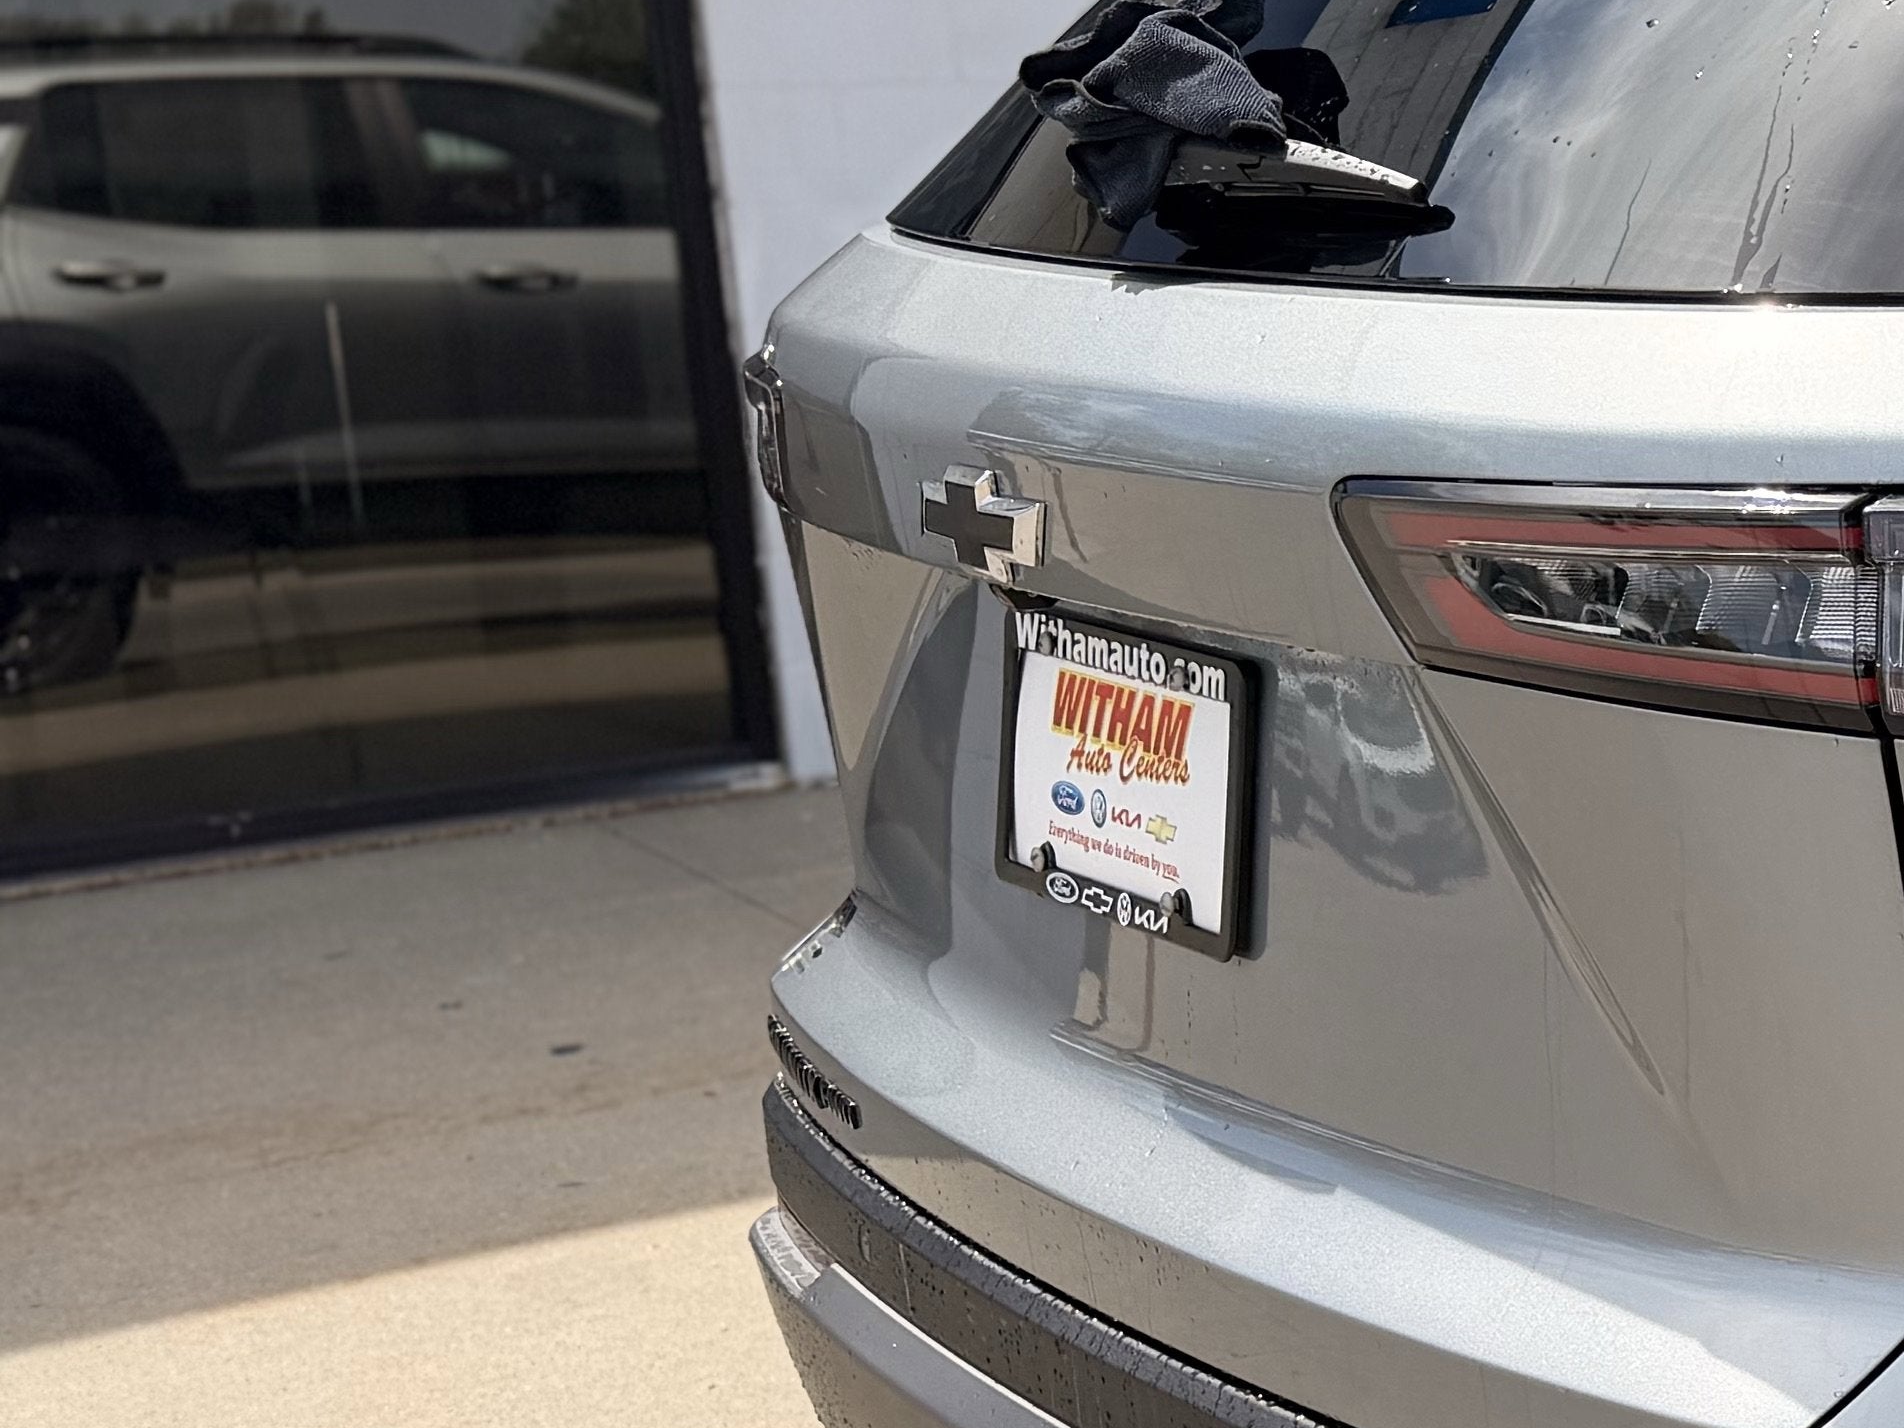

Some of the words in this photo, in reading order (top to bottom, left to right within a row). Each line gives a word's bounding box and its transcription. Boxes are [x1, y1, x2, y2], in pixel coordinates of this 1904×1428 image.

[1052, 669, 1194, 758] WITHAM
[1067, 734, 1112, 774] Auto
[1119, 735, 1191, 786] Centers
